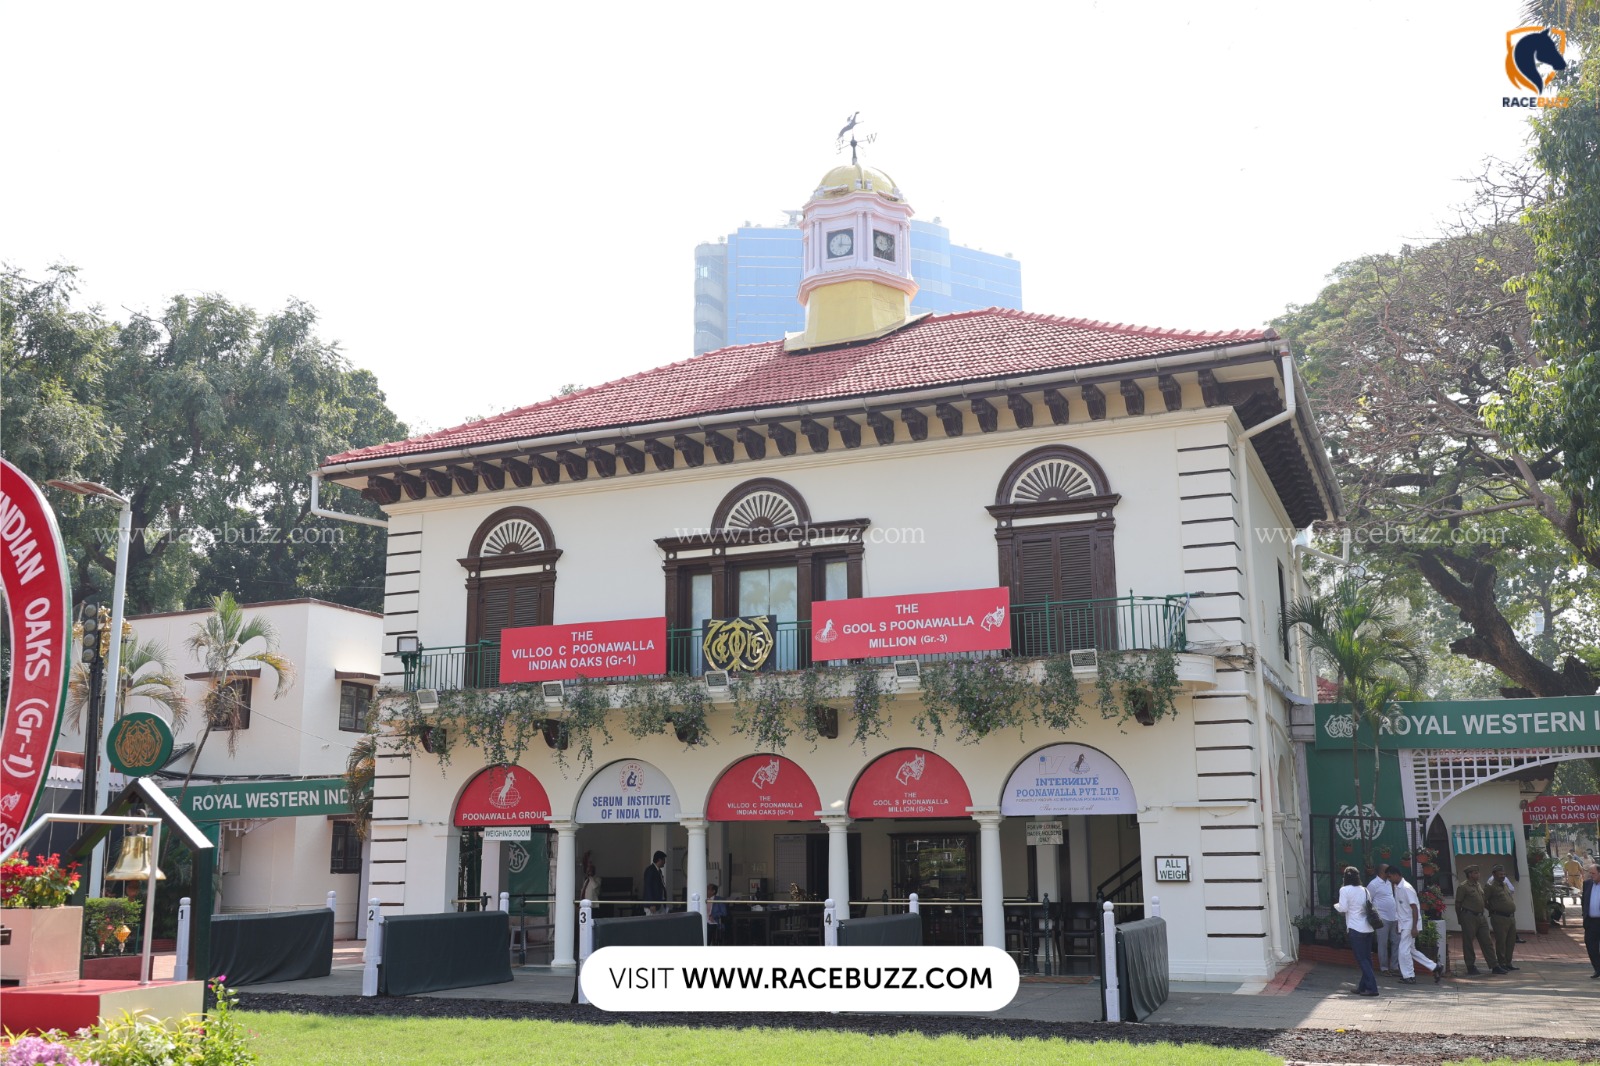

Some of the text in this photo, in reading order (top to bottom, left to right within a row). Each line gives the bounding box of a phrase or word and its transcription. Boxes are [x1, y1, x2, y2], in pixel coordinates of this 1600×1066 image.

[895, 603, 919, 615] THE
[842, 615, 975, 635] GOOL S POONAWALLA
[0, 491, 52, 779] NDIAN OAKS (Gr-1)
[571, 630, 594, 642] THE
[869, 635, 917, 649] MILLION
[512, 640, 655, 660] VILLOO C POONAWALLA
[528, 654, 636, 671] INDIAN OAKS (Gr-1)
[1378, 715, 1457, 735] ROYAL
[1461, 710, 1586, 735] WESTERN
[1036, 776, 1099, 786] INTERVALVE
[1016, 788, 1077, 797] POONAWALLA
[192, 793, 242, 812] ROYAL
[245, 789, 320, 809] WESTERN
[592, 795, 671, 807] SERUM INSTITUTE
[462, 810, 548, 821] POONAWALLA GROUP
[601, 808, 662, 819] OF INDIA LTD.
[485, 829, 530, 838] WEIGHING ROOM
[1165, 859, 1181, 869] ALL
[1159, 870, 1187, 879] WEIGH
[178, 909, 184, 919] 1
[368, 909, 374, 921] 2
[580, 911, 587, 924] 3
[825, 913, 832, 926] 4
